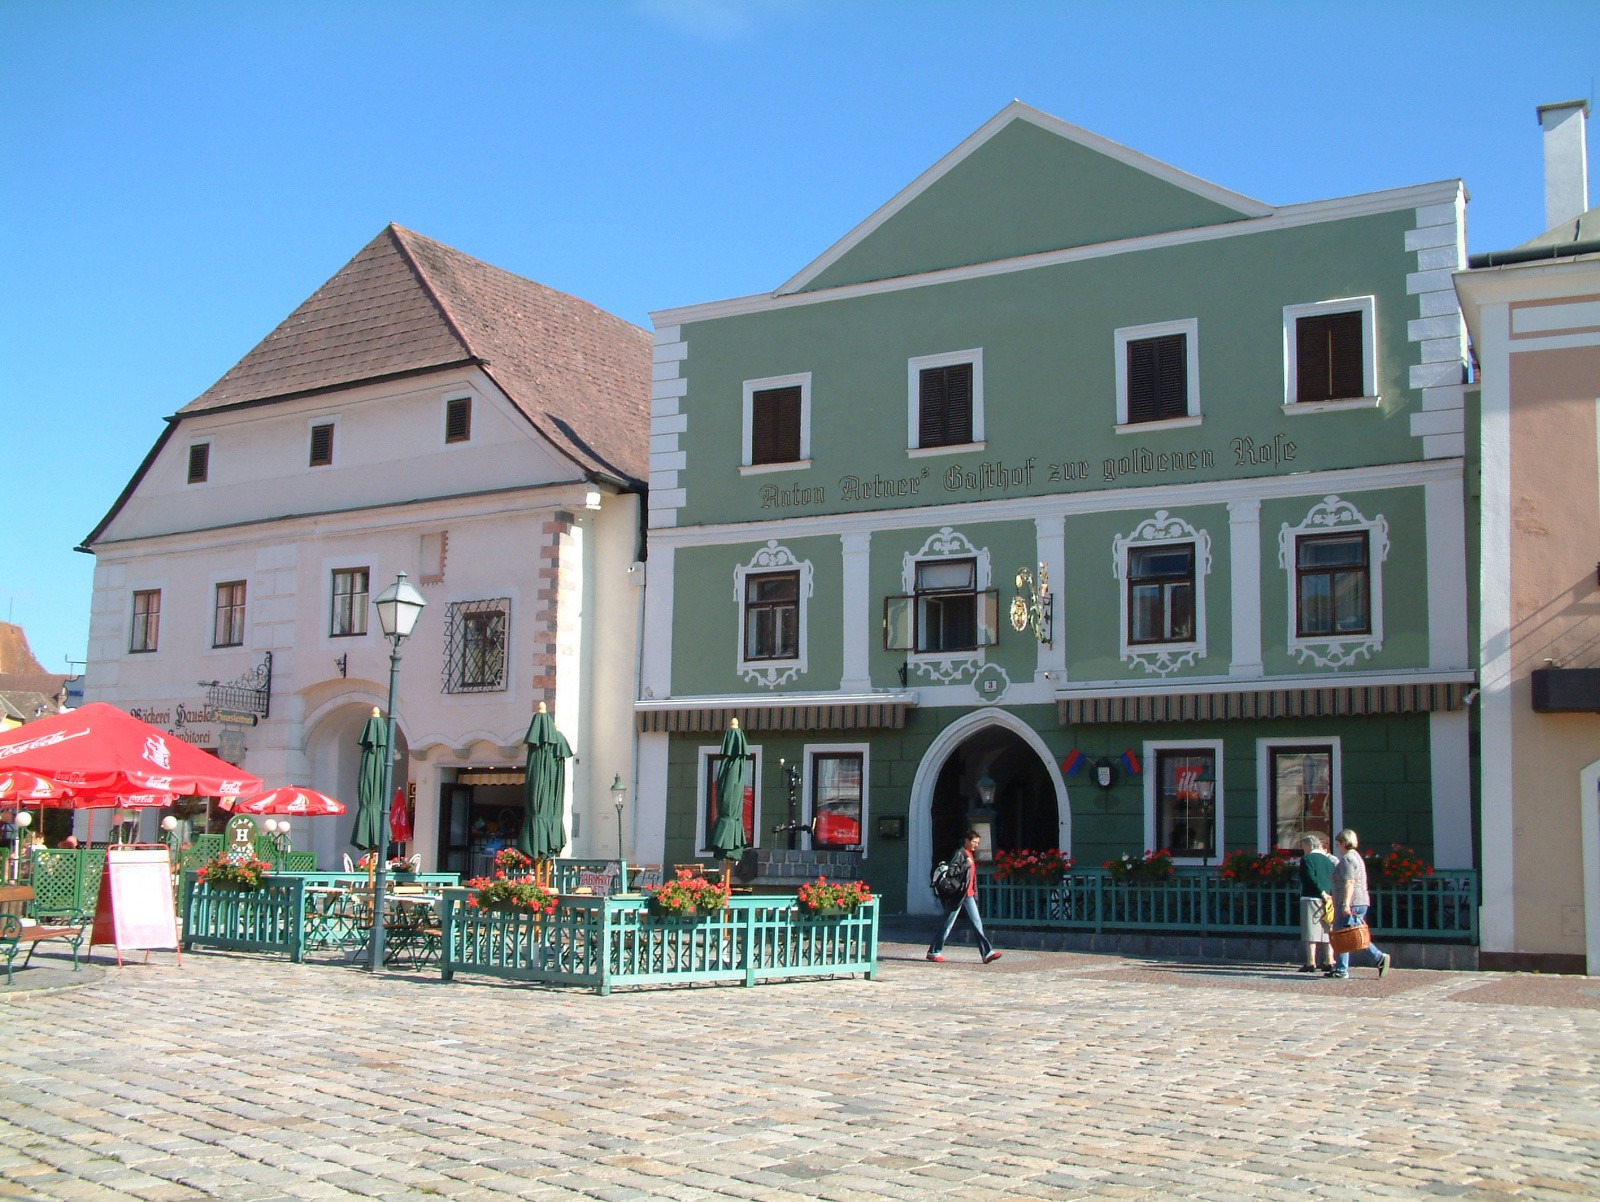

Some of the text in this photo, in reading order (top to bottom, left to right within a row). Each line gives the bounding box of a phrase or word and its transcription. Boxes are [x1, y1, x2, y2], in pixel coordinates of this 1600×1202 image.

[759, 482, 825, 510] Anton
[1049, 460, 1089, 483] zur
[1103, 446, 1215, 482] goldenen
[235, 828, 249, 842] H
